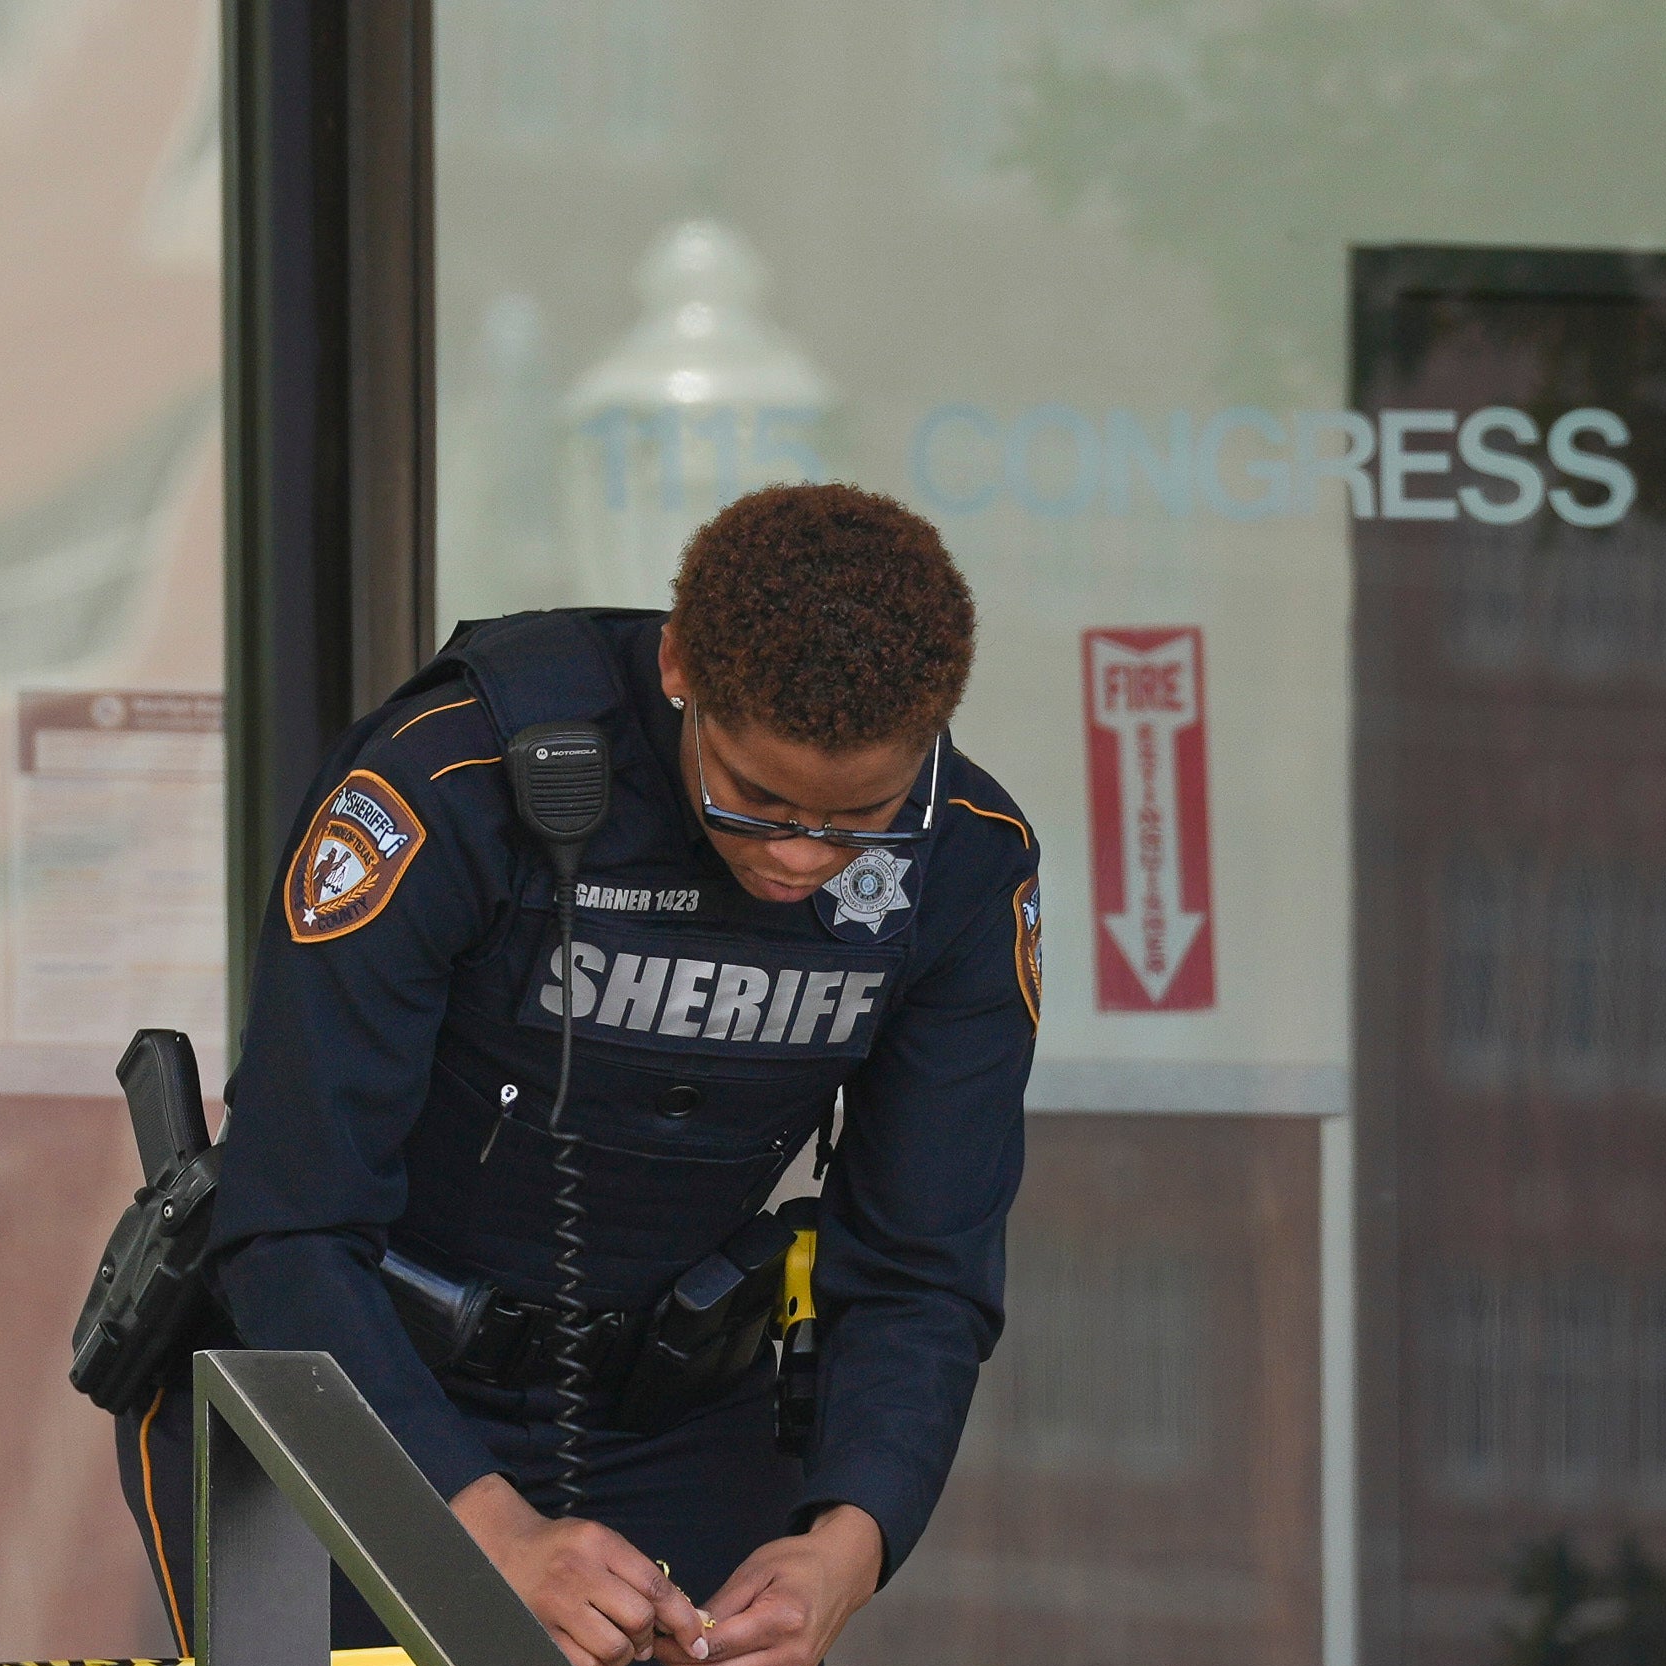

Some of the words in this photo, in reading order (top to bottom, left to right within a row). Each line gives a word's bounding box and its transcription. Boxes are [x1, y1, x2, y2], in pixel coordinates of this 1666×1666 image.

[579, 404, 828, 511] 1115
[908, 403, 1635, 528] CONGRESS
[1103, 662, 1184, 712] FIRE
[550, 748, 597, 757] MOTOROLA
[345, 791, 395, 834] SHERIFF
[317, 896, 369, 931] COUNTY
[575, 883, 652, 911] GARNER
[655, 889, 700, 912] 1423
[539, 941, 886, 1045] SHERIFF
